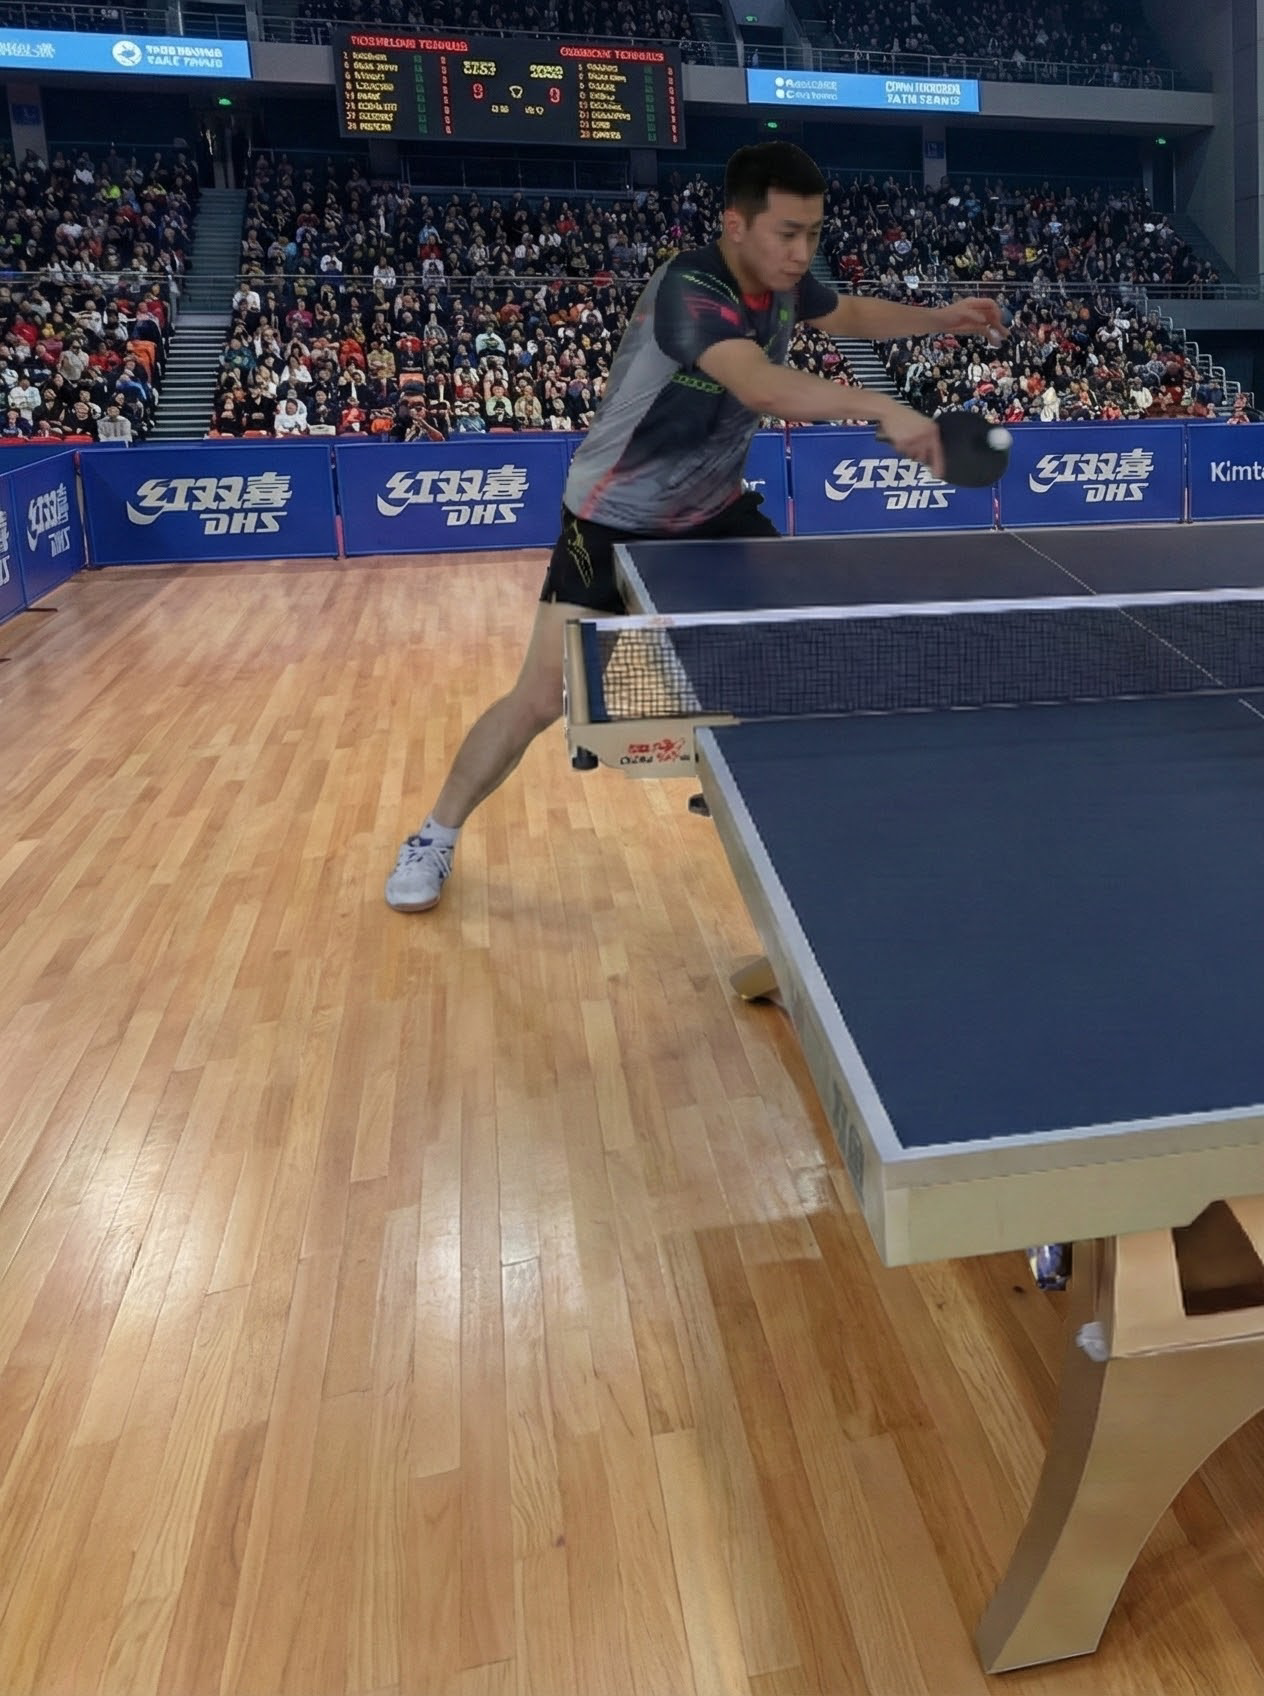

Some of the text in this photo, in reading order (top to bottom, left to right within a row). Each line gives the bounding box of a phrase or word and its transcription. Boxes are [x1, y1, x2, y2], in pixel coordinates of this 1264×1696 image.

[1029, 448, 1154, 493] 红双喜
[127, 472, 293, 525] 红双喜
[377, 465, 530, 517] 红双喜
[883, 489, 956, 510] DHS
[1082, 483, 1149, 502] DHS
[200, 511, 288, 535] DHS
[442, 503, 525, 526] DHS
